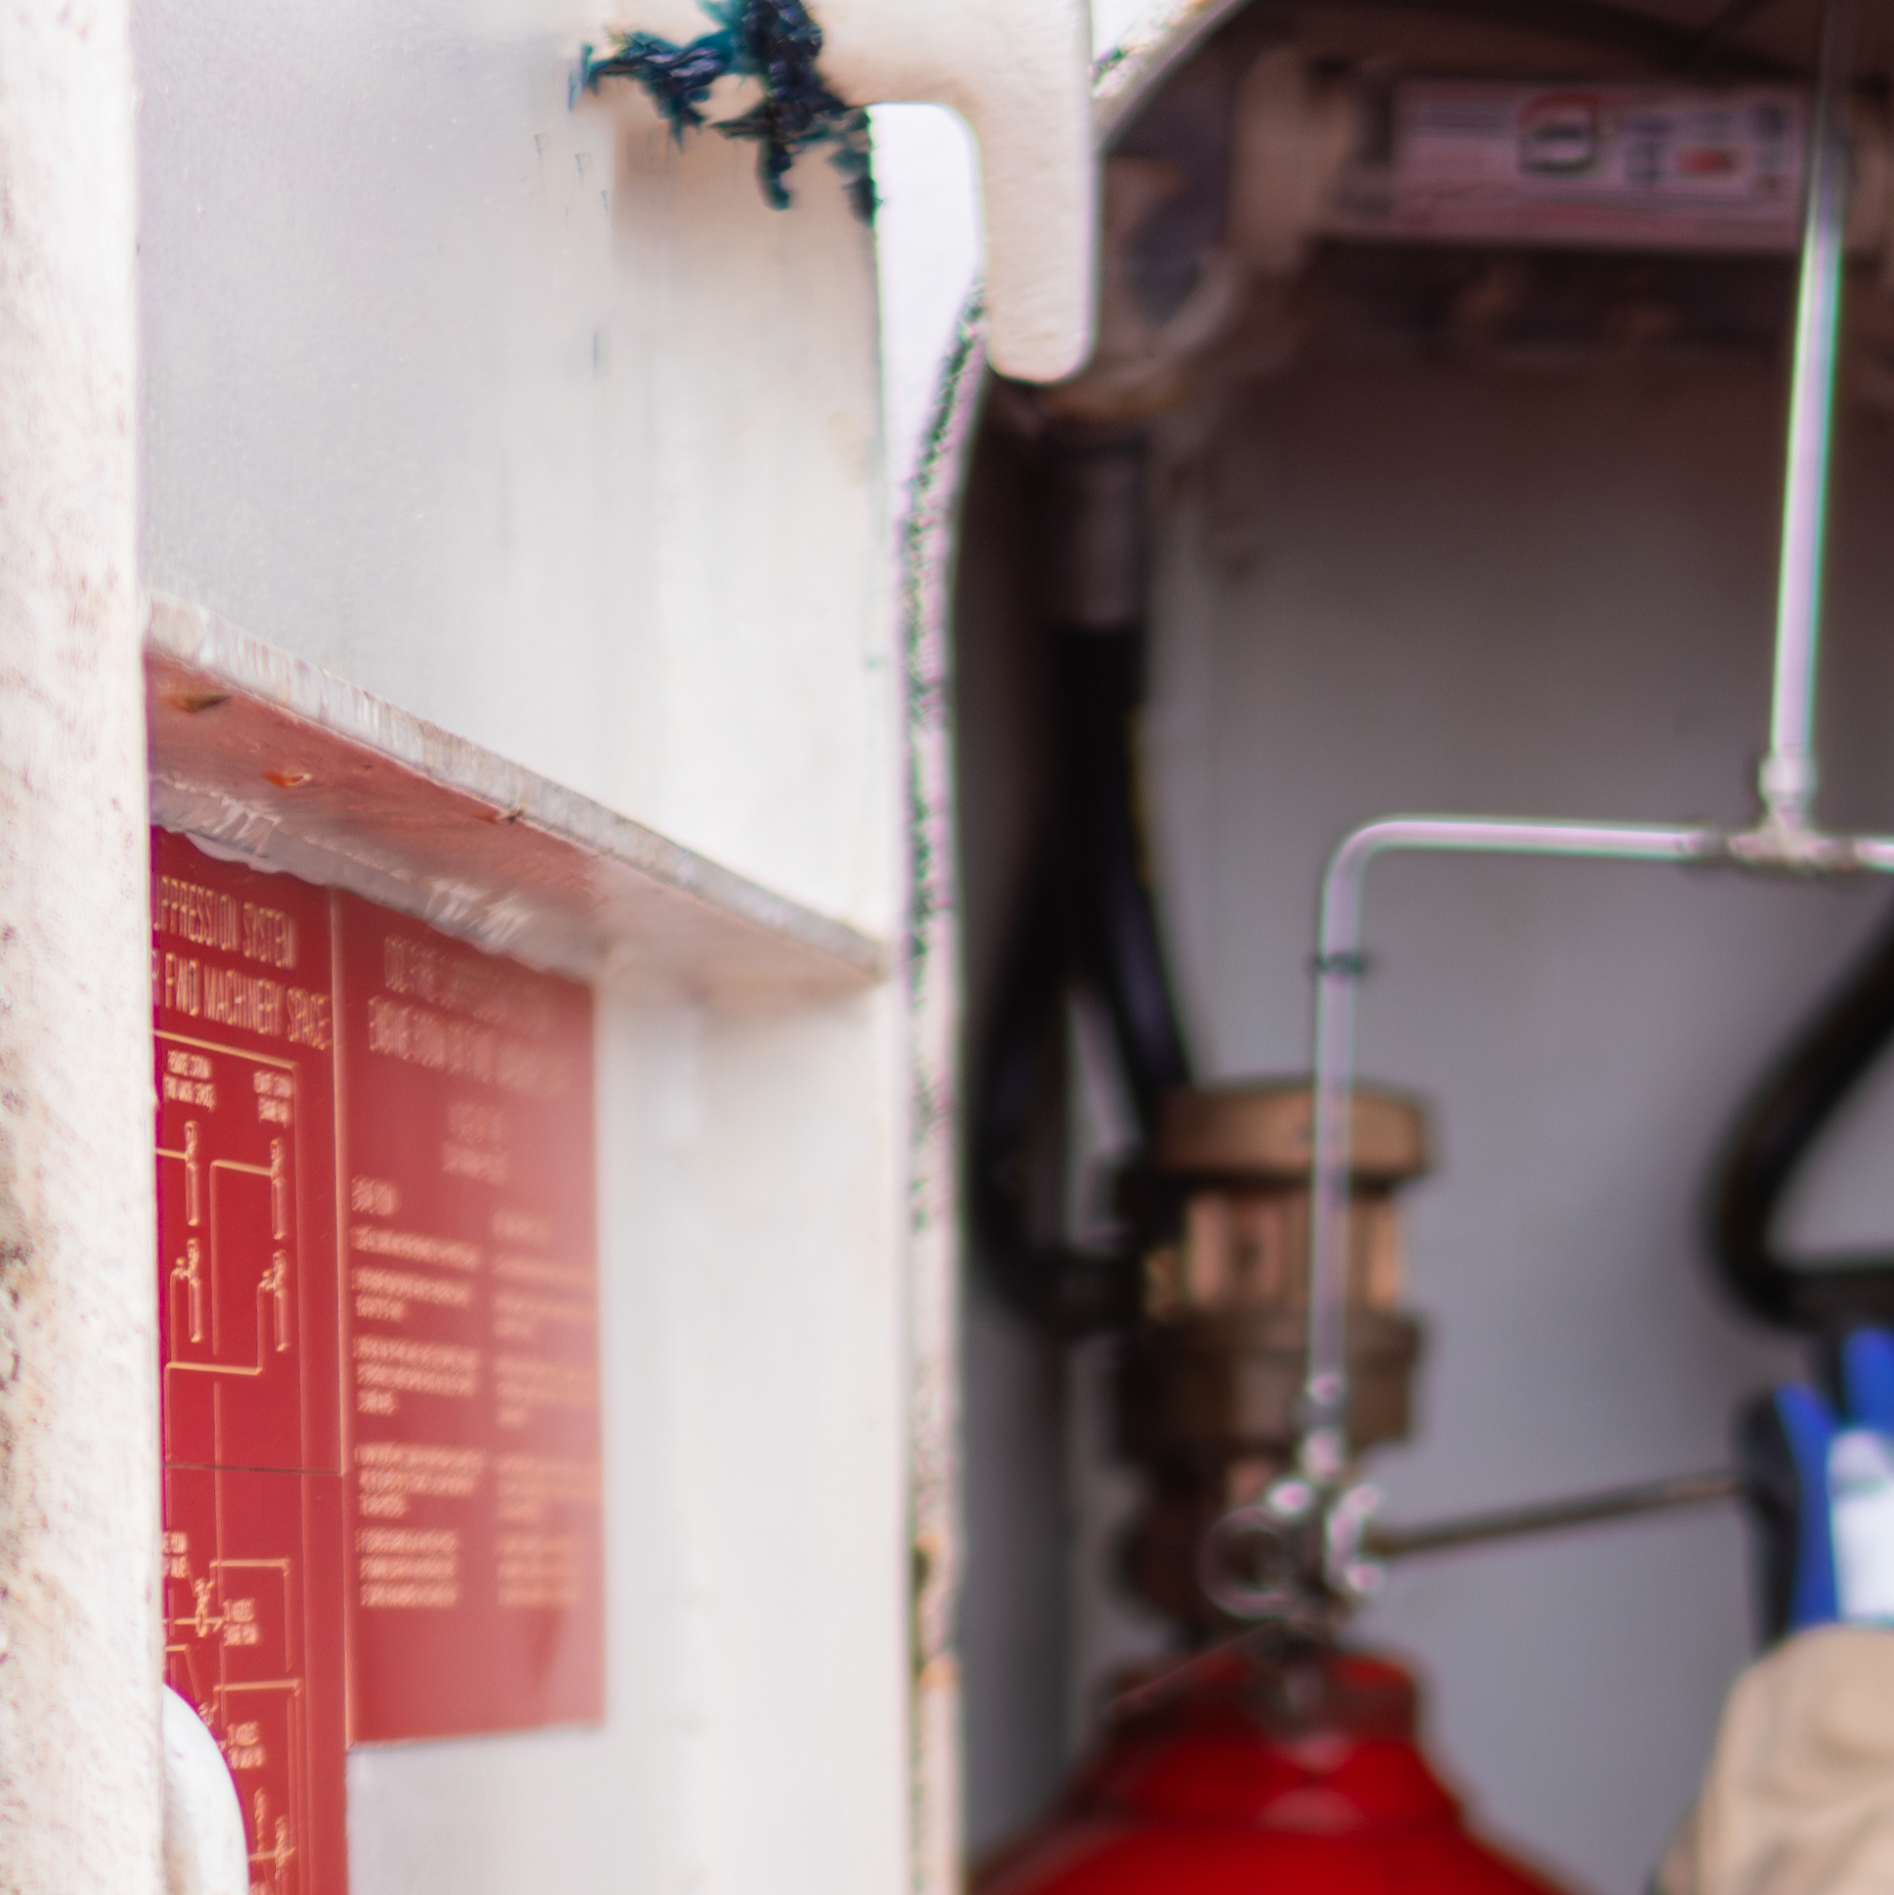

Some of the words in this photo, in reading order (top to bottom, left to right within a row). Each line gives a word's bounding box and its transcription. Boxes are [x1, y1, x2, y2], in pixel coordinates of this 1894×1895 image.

[243, 902, 297, 970] SYSTEM
[165, 953, 199, 1016] FWD
[204, 964, 286, 1037] MACHINERY
[286, 986, 333, 1050] SPACE
